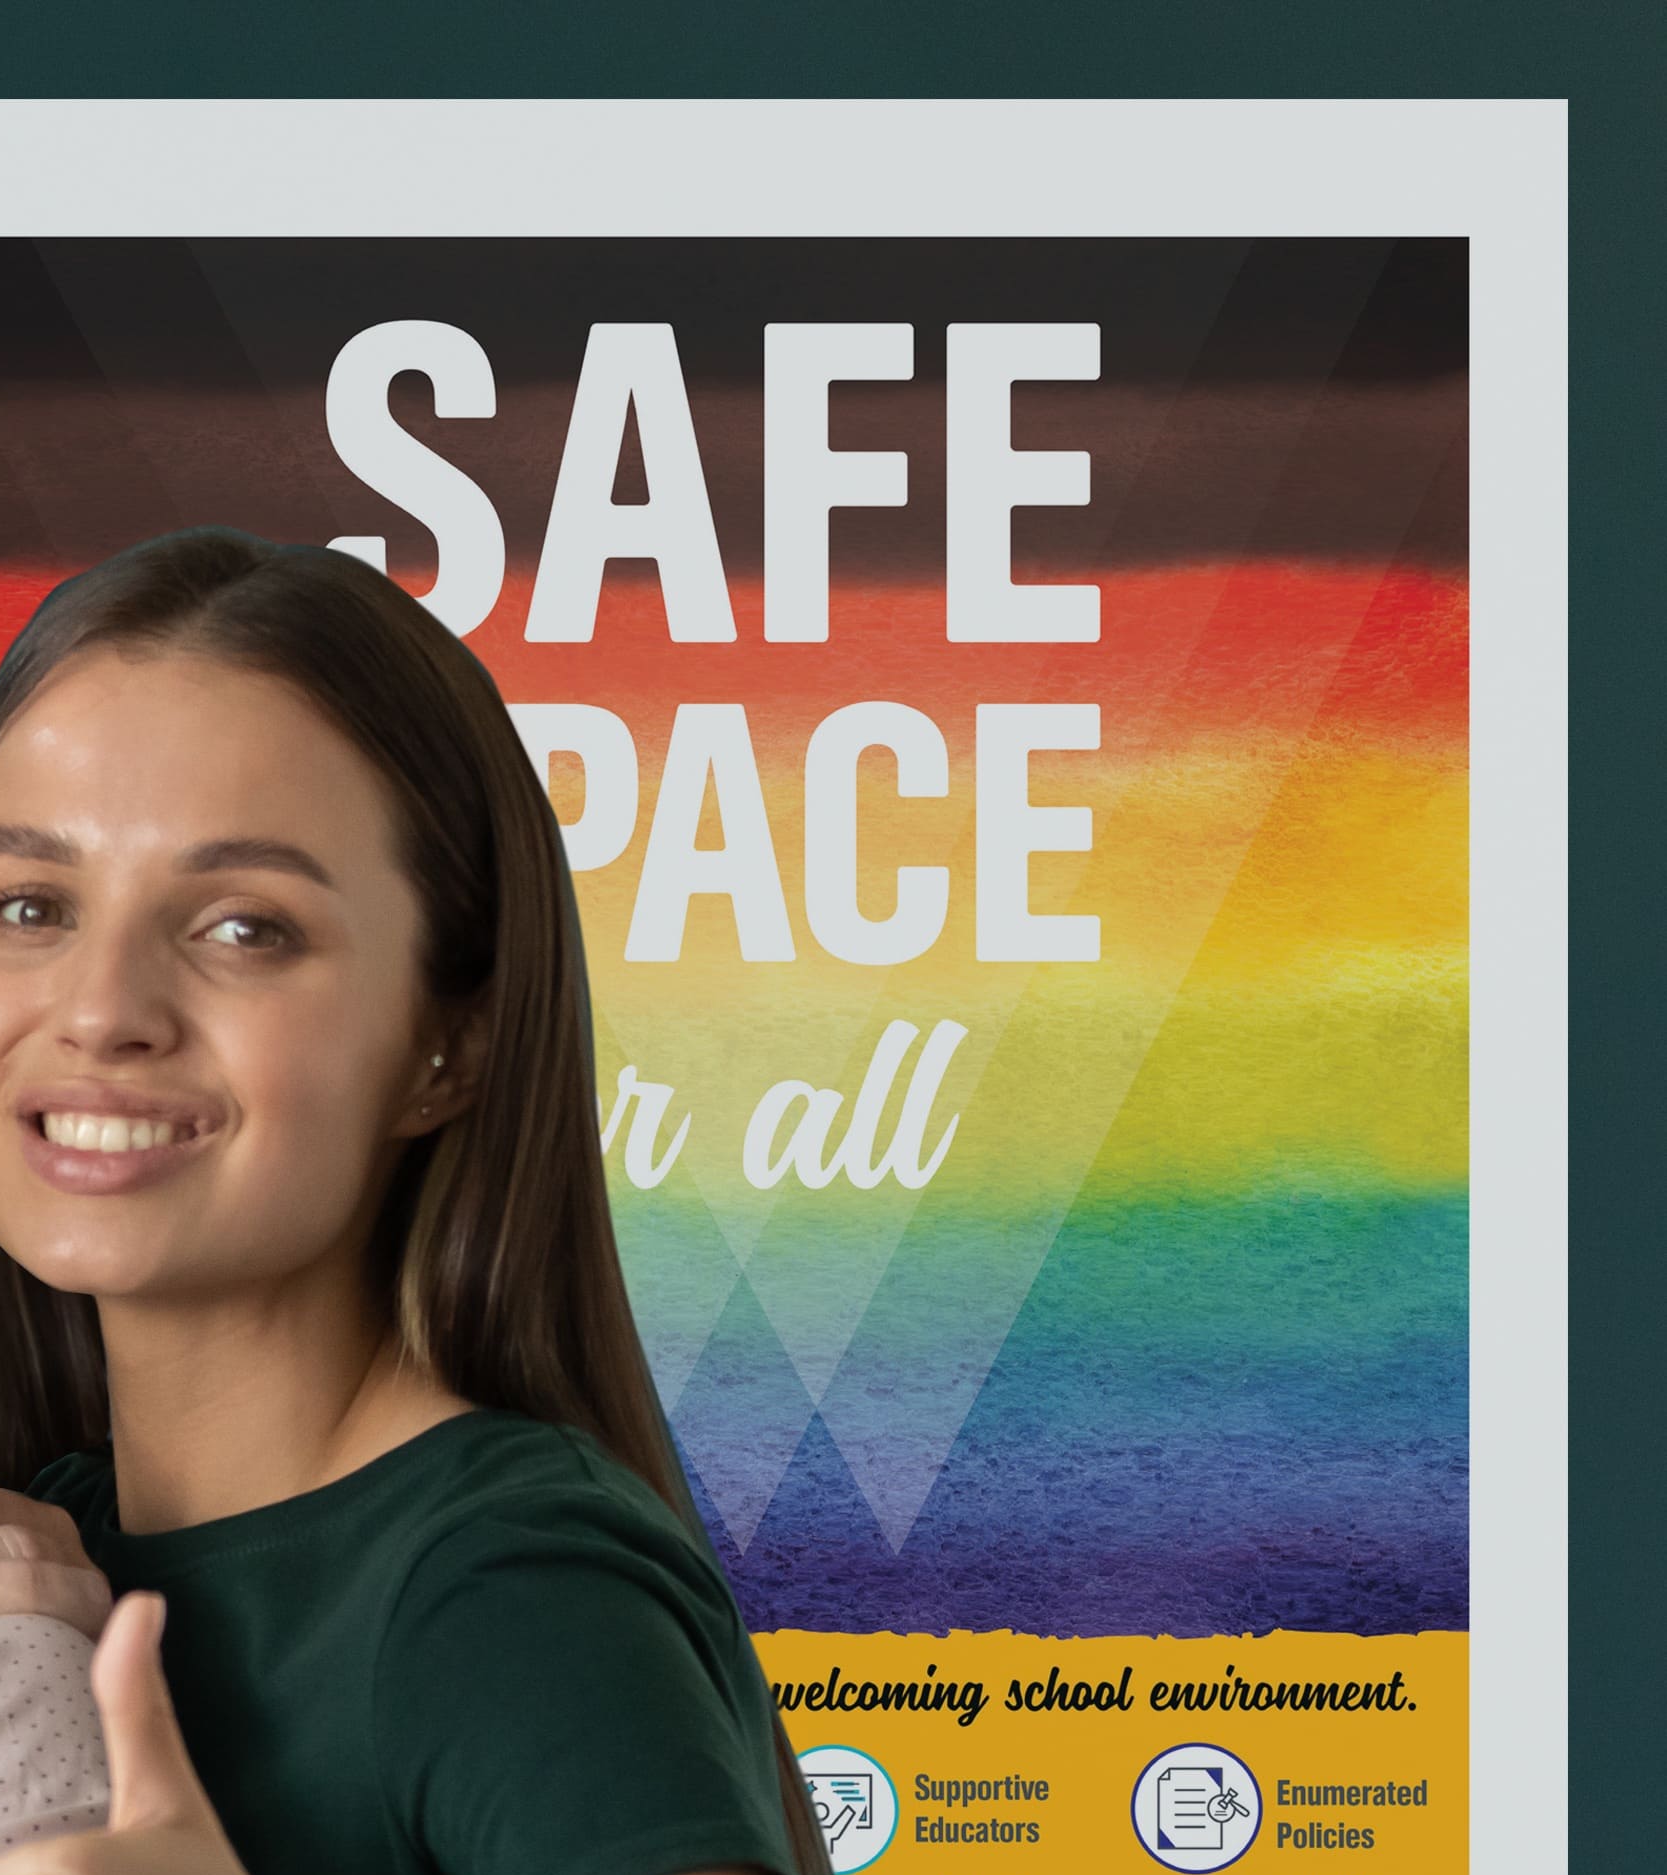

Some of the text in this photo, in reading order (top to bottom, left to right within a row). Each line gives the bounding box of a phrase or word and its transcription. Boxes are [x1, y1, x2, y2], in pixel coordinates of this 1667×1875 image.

[324, 319, 1102, 644] SAFE
[507, 701, 1102, 966] PACE
[742, 1018, 969, 1190] all
[771, 1663, 1418, 1727] welcoming school environment.
[914, 1773, 1050, 1808] Supportive
[1276, 1779, 1429, 1807] Enumerated
[914, 1816, 1040, 1844] Educators
[1276, 1822, 1376, 1850] Policies
